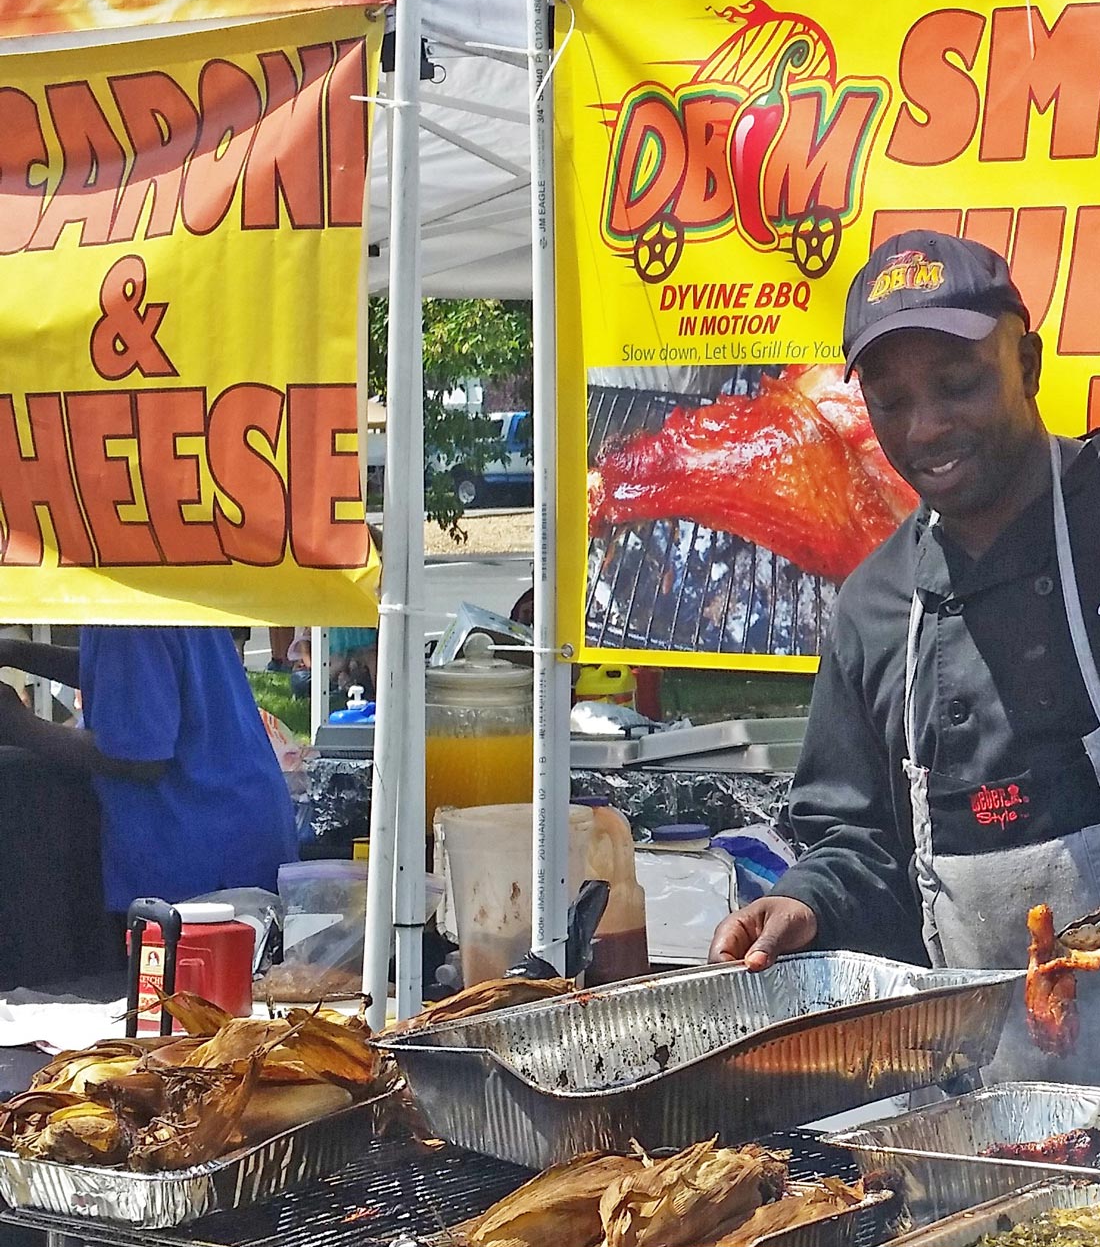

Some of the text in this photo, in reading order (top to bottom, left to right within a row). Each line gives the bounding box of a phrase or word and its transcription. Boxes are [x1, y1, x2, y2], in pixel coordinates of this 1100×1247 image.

[538, 180, 546, 215] EAGLE
[539, 218, 546, 232] JM
[659, 280, 812, 313] DYVINE BBQ
[90, 255, 178, 381] &
[677, 314, 781, 337] IN MOTION
[621, 338, 842, 364] Slow down, Let Us Grill for You
[0, 382, 368, 568] HEESE
